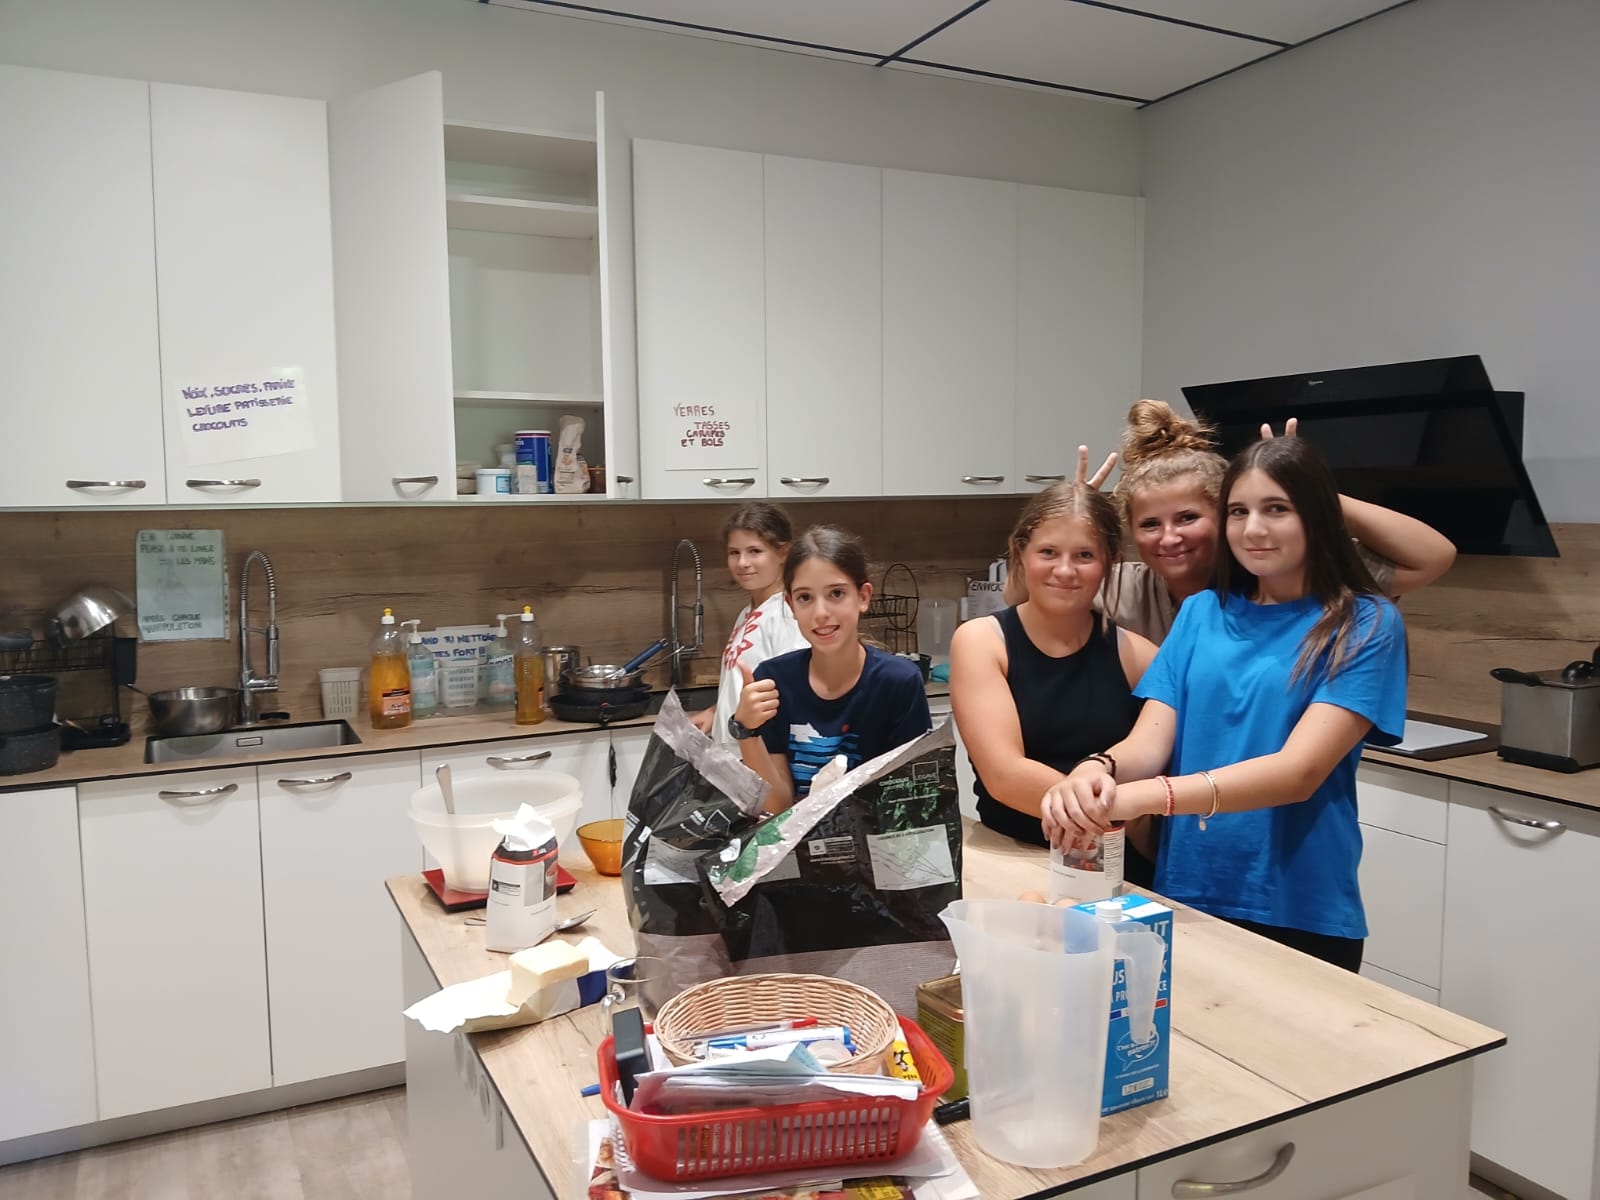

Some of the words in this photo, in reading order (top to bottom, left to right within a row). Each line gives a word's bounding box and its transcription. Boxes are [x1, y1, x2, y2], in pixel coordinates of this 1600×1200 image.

[673, 403, 715, 417] VERRES
[694, 421, 730, 430] TASSES
[702, 438, 723, 447] BOLS
[453, 648, 477, 657] FORT
